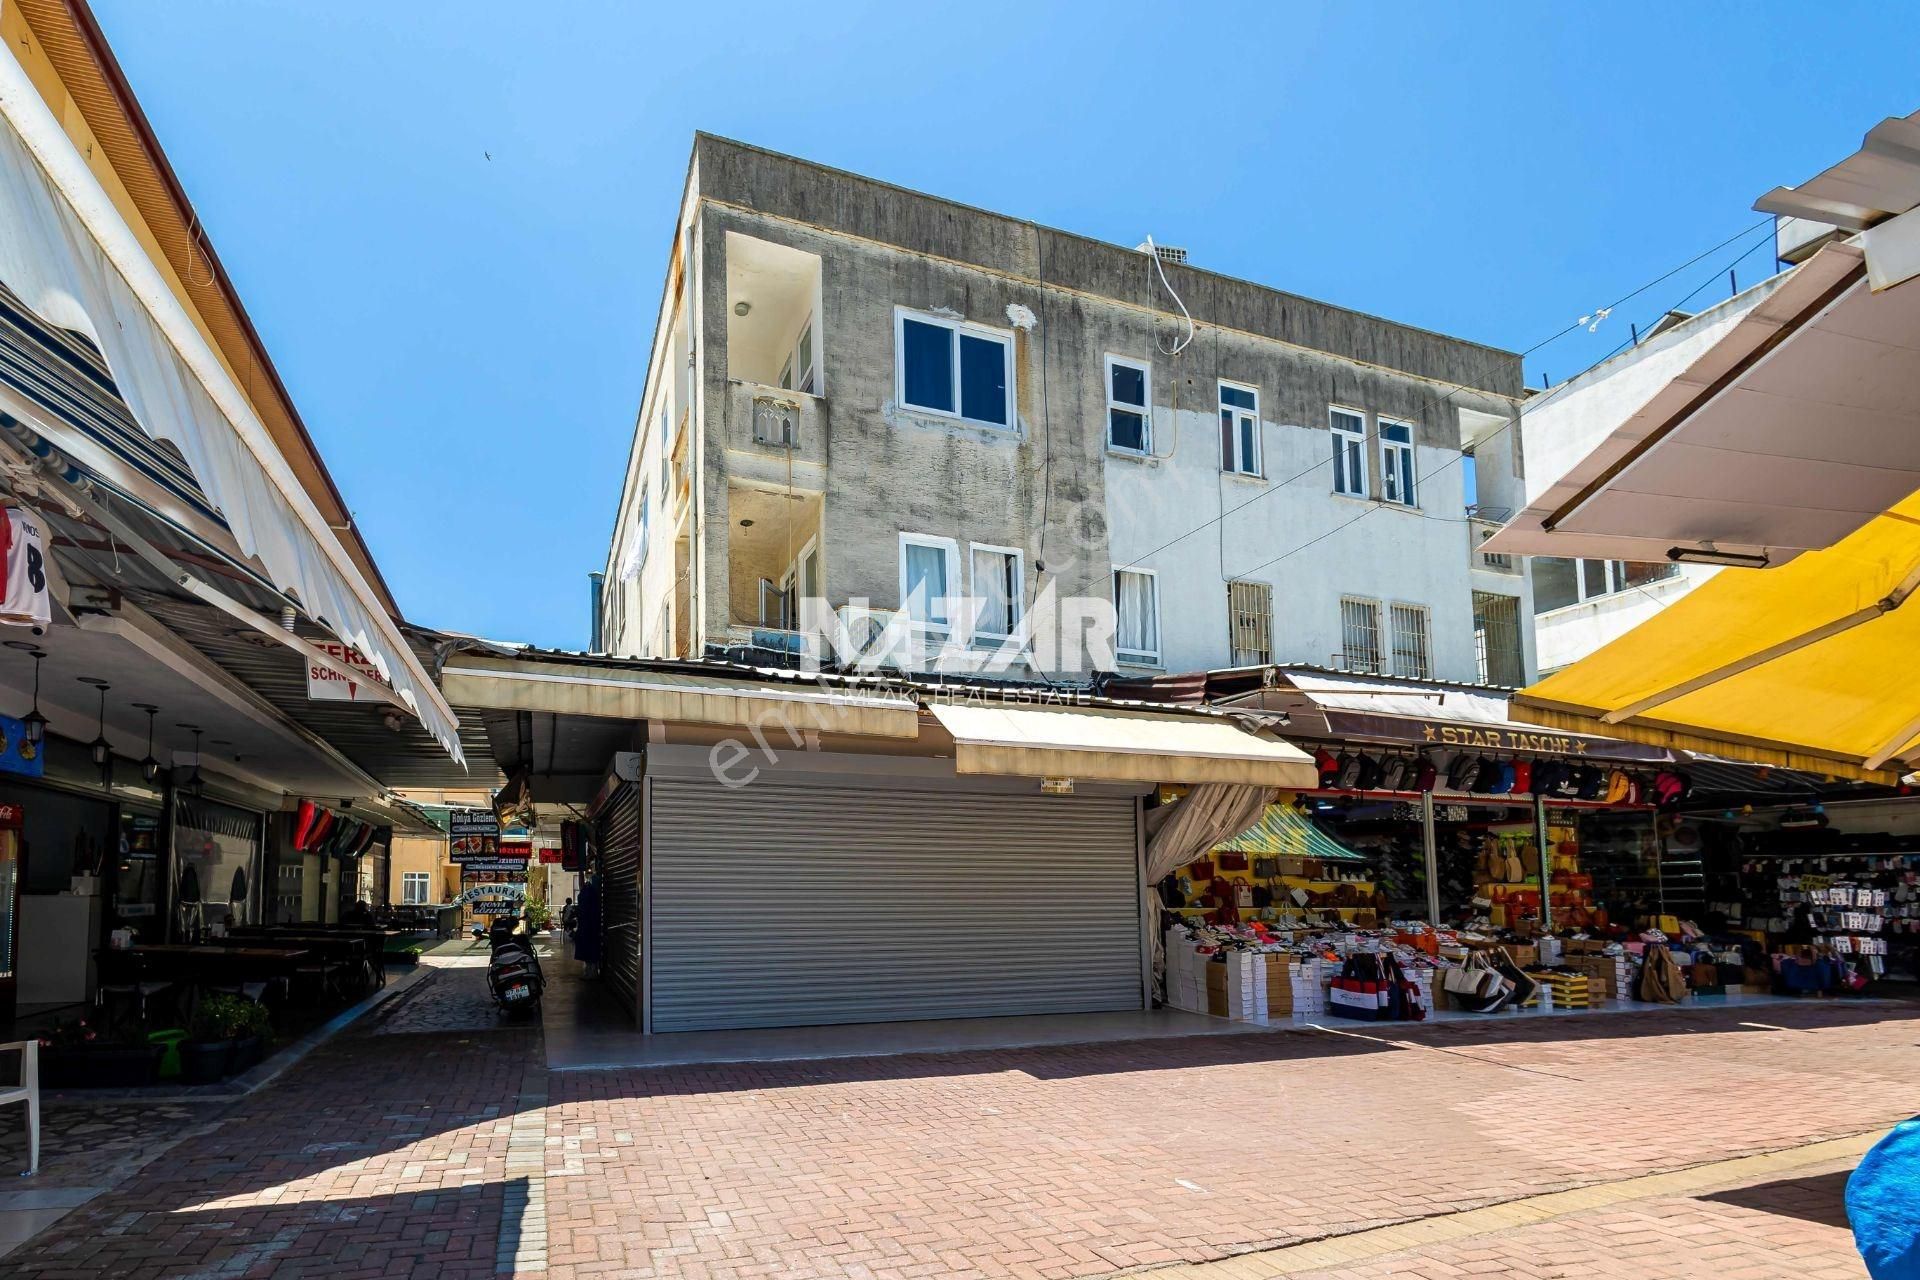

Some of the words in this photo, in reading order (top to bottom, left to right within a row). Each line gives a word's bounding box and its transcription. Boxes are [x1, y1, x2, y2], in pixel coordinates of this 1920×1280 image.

[27, 543, 45, 593] 8
[311, 667, 383, 682] SCHNER
[1441, 726, 1501, 748] STAR
[1507, 733, 1570, 752] TASCHE
[461, 886, 525, 903] RESTAURAN
